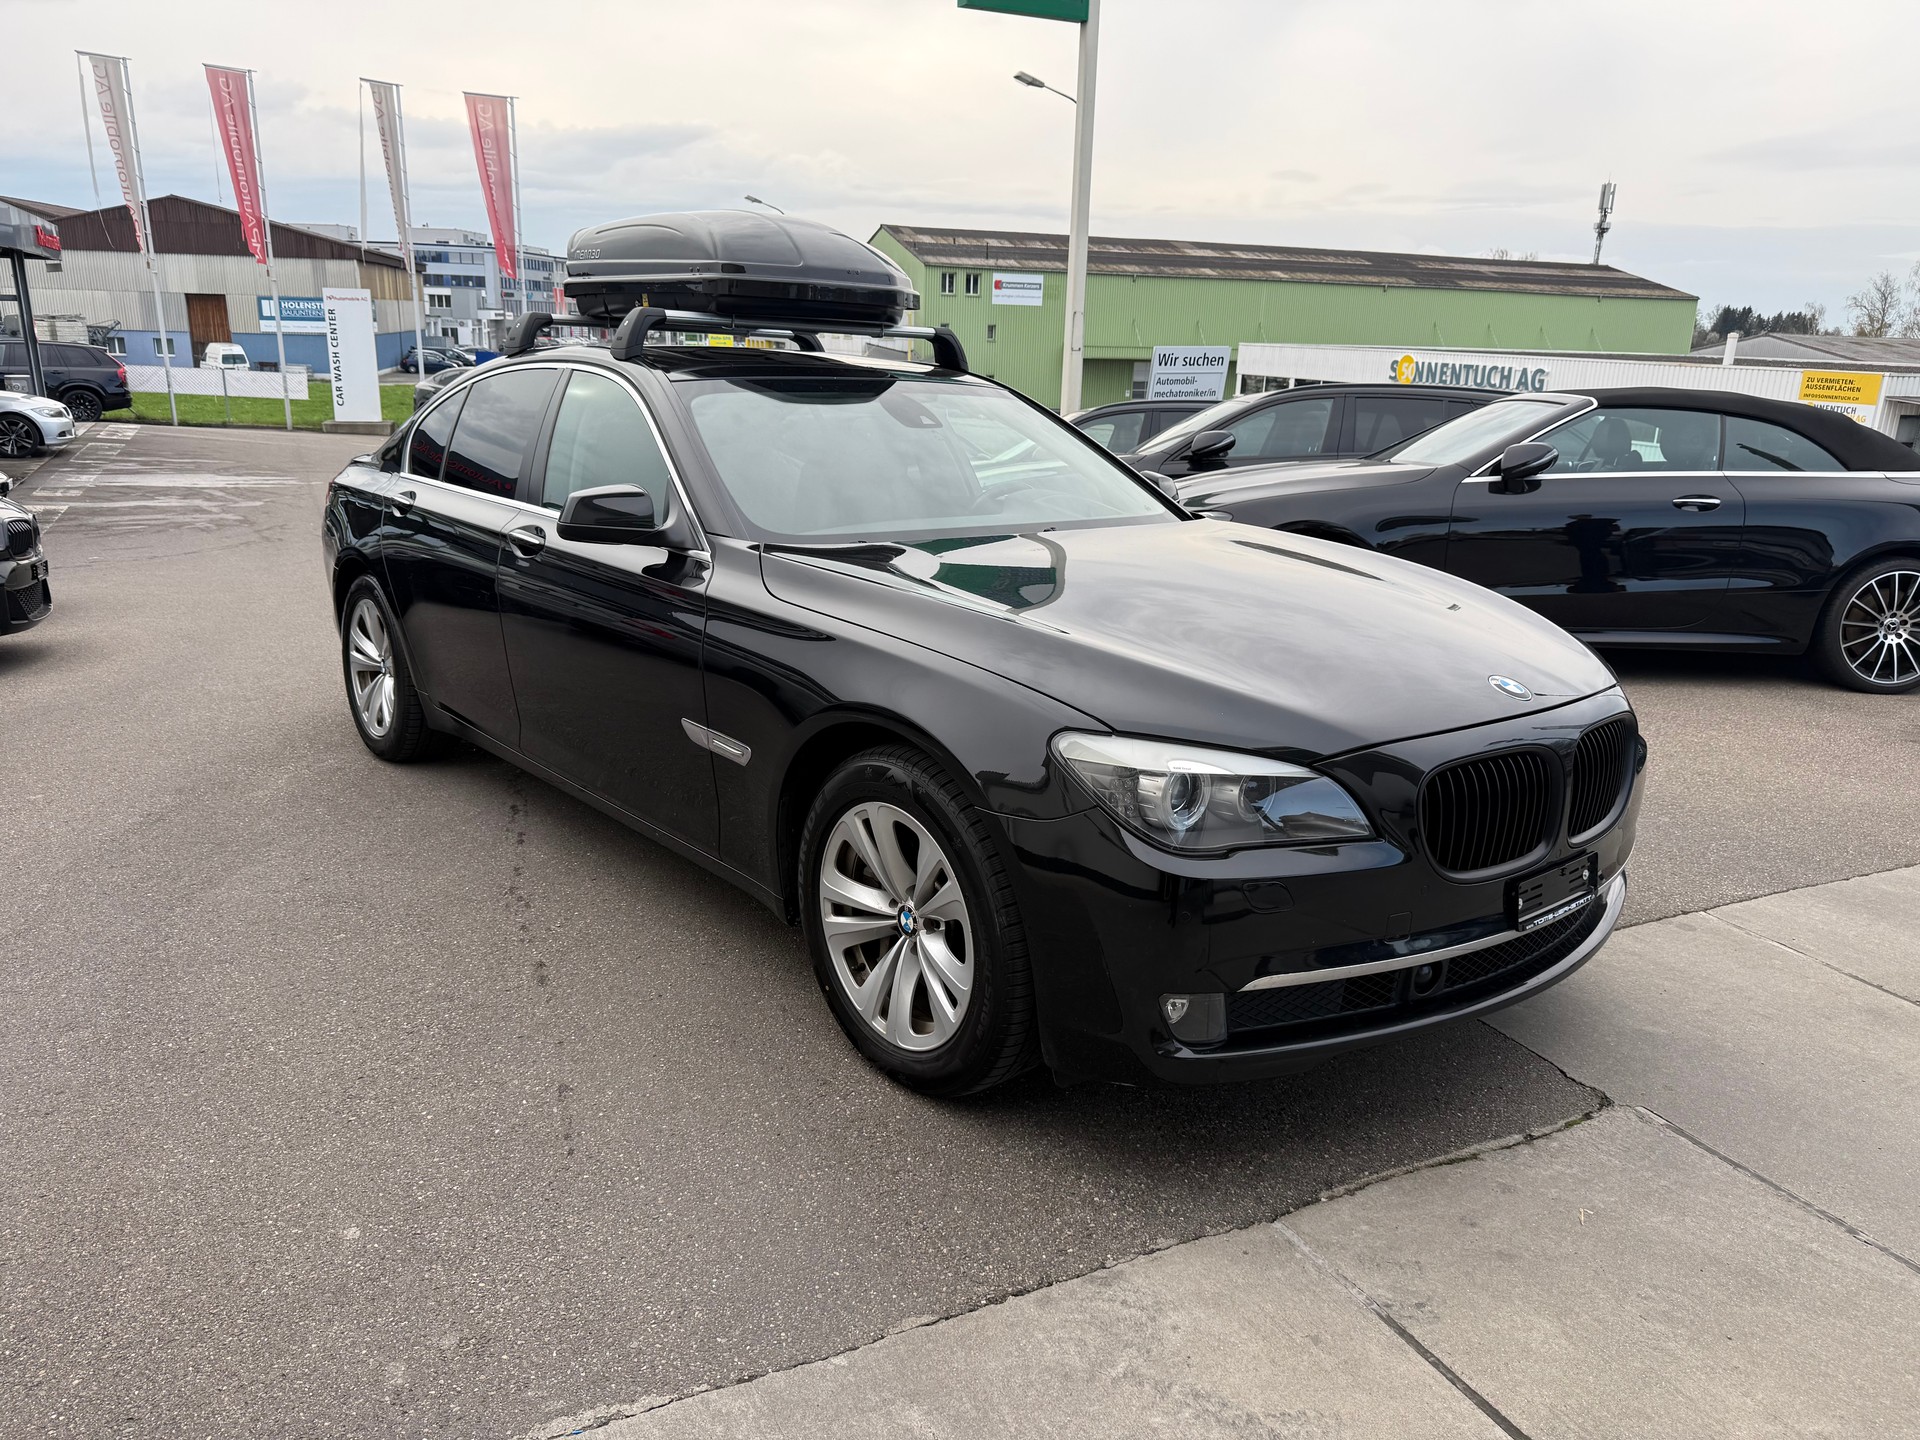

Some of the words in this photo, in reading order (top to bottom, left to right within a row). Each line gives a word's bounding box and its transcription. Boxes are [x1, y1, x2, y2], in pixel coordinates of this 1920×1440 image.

[327, 308, 339, 348] CENTER
[332, 351, 343, 383] WASH
[1158, 352, 1179, 367] Wir
[1181, 352, 1225, 367] suchen
[1155, 376, 1198, 386] Automobil-
[1515, 367, 1546, 393] AG
[1805, 383, 1862, 393] AUSSENFLÄCHEN
[335, 385, 345, 407] CAR
[1154, 388, 1217, 398] mechatroniker/in
